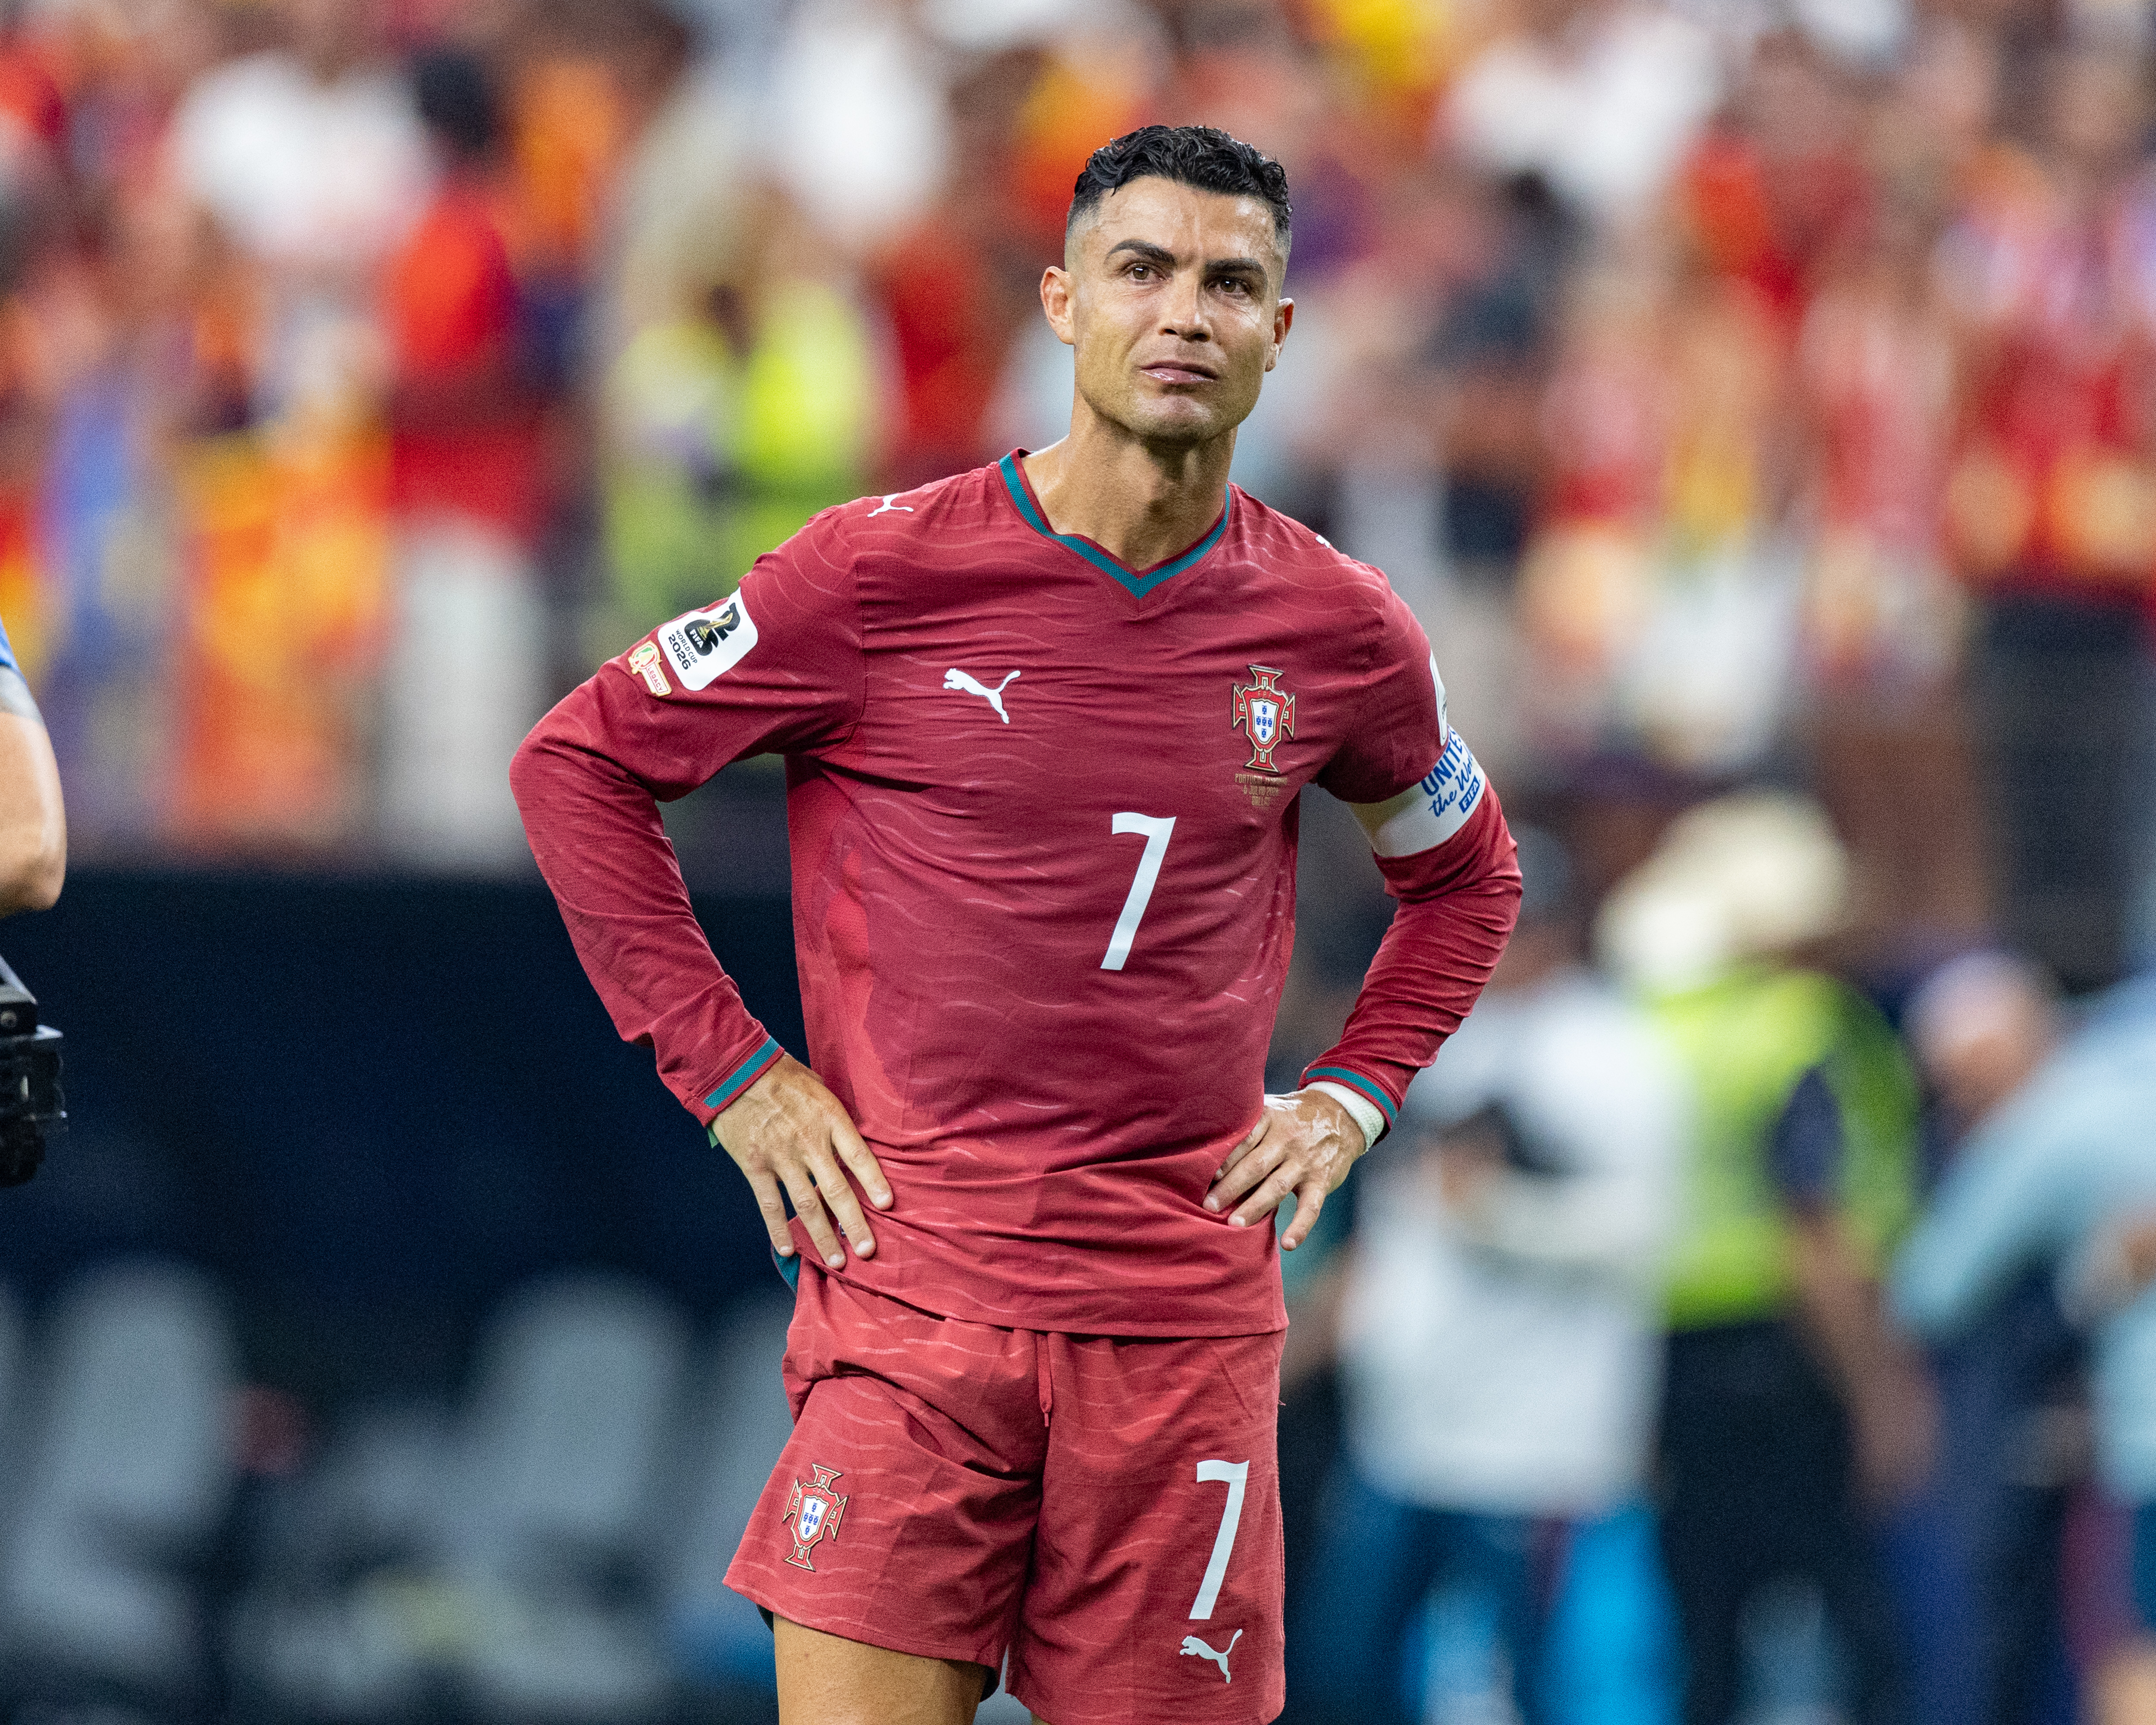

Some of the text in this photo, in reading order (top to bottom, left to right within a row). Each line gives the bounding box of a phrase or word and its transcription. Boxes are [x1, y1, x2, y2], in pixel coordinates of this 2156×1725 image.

[668, 634, 691, 670] 2026
[676, 629, 698, 664] WORLD CUP
[690, 629, 704, 648] FIFA
[648, 666, 663, 691] LEGACY
[1428, 789, 1457, 817] the
[1460, 779, 1479, 812] FIFA
[1100, 811, 1177, 971] 7
[1188, 1459, 1250, 1620] 7
